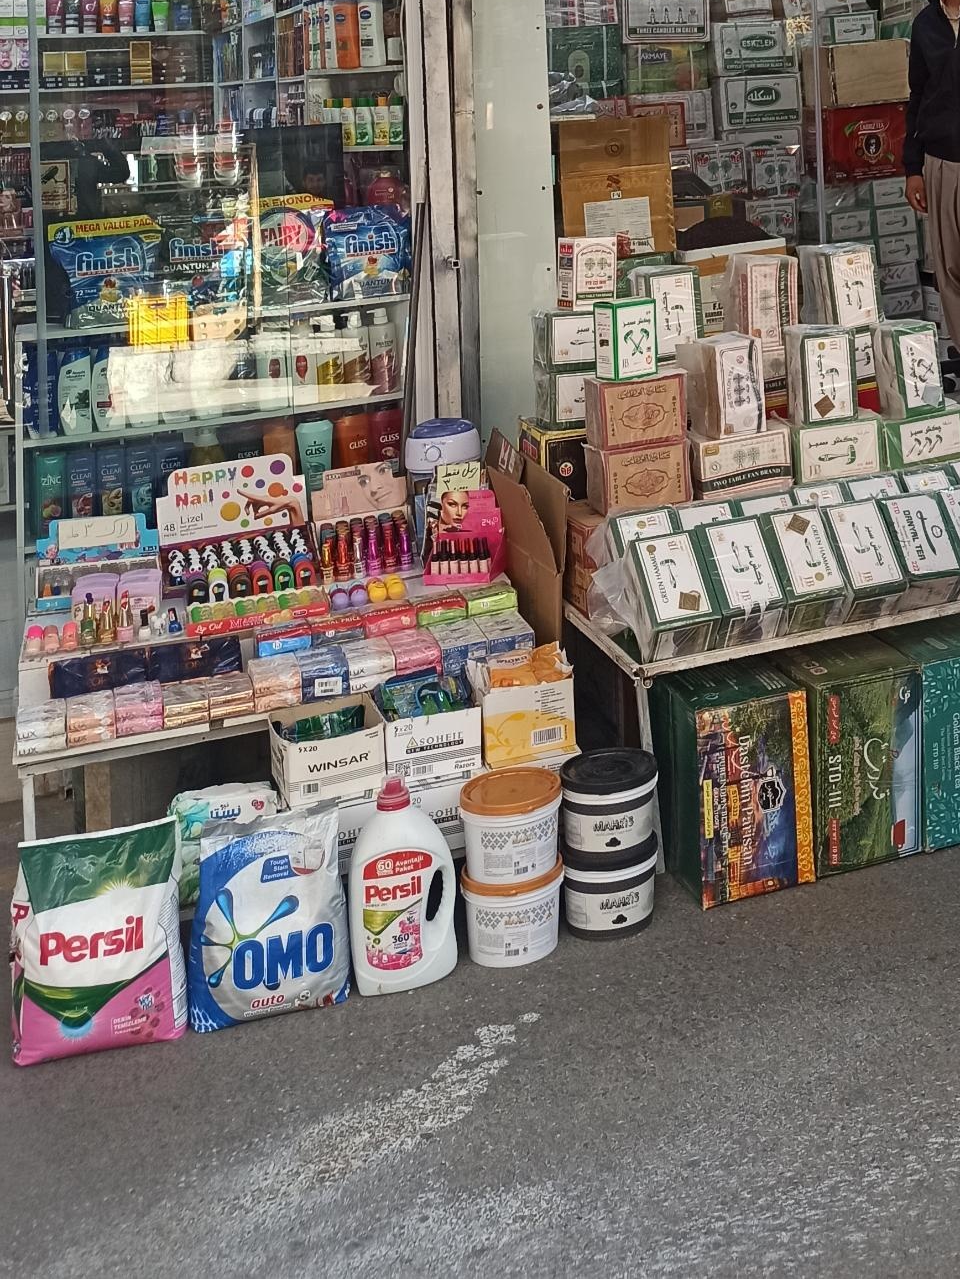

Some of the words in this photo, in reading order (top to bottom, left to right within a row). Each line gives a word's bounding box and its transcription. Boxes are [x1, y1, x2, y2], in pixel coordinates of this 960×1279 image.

[748, 88, 776, 101] اسکله
[75, 223, 101, 234] MEGA
[104, 221, 130, 230] VALUE
[345, 232, 396, 254] finish
[76, 248, 140, 274] finish
[360, 278, 392, 288] UANTUM
[380, 432, 399, 443] GLISS
[349, 439, 367, 450] GLISS
[305, 446, 326, 457] GLISS
[101, 467, 121, 476] CLEAR
[130, 462, 151, 471] CLEAR
[41, 476, 61, 486] ZINC
[70, 472, 91, 481] CLEAR
[174, 466, 237, 490] Happy
[713, 479, 727, 488] TWO
[728, 476, 747, 485] TABLE
[759, 469, 781, 479] BRAND
[175, 489, 214, 509] Nail
[891, 502, 901, 515] STD
[163, 524, 176, 533] 48
[903, 509, 919, 543] DANYAL
[811, 524, 823, 546] GREEN
[818, 545, 833, 577] HAMMER
[351, 683, 368, 692] LUX
[952, 712, 960, 740] Golden
[17, 730, 36, 740] LUX
[18, 745, 38, 755] LUX
[308, 752, 369, 773] WINSAR
[455, 762, 476, 770] Razors
[269, 858, 289, 867] Tough
[378, 860, 393, 871] 60
[273, 865, 289, 873] Stain
[395, 864, 414, 873] Paket
[262, 871, 289, 882] Removal
[365, 876, 422, 904] Persil
[39, 915, 144, 966] Persil
[232, 922, 334, 990] OMO
[251, 994, 285, 1010] auto
